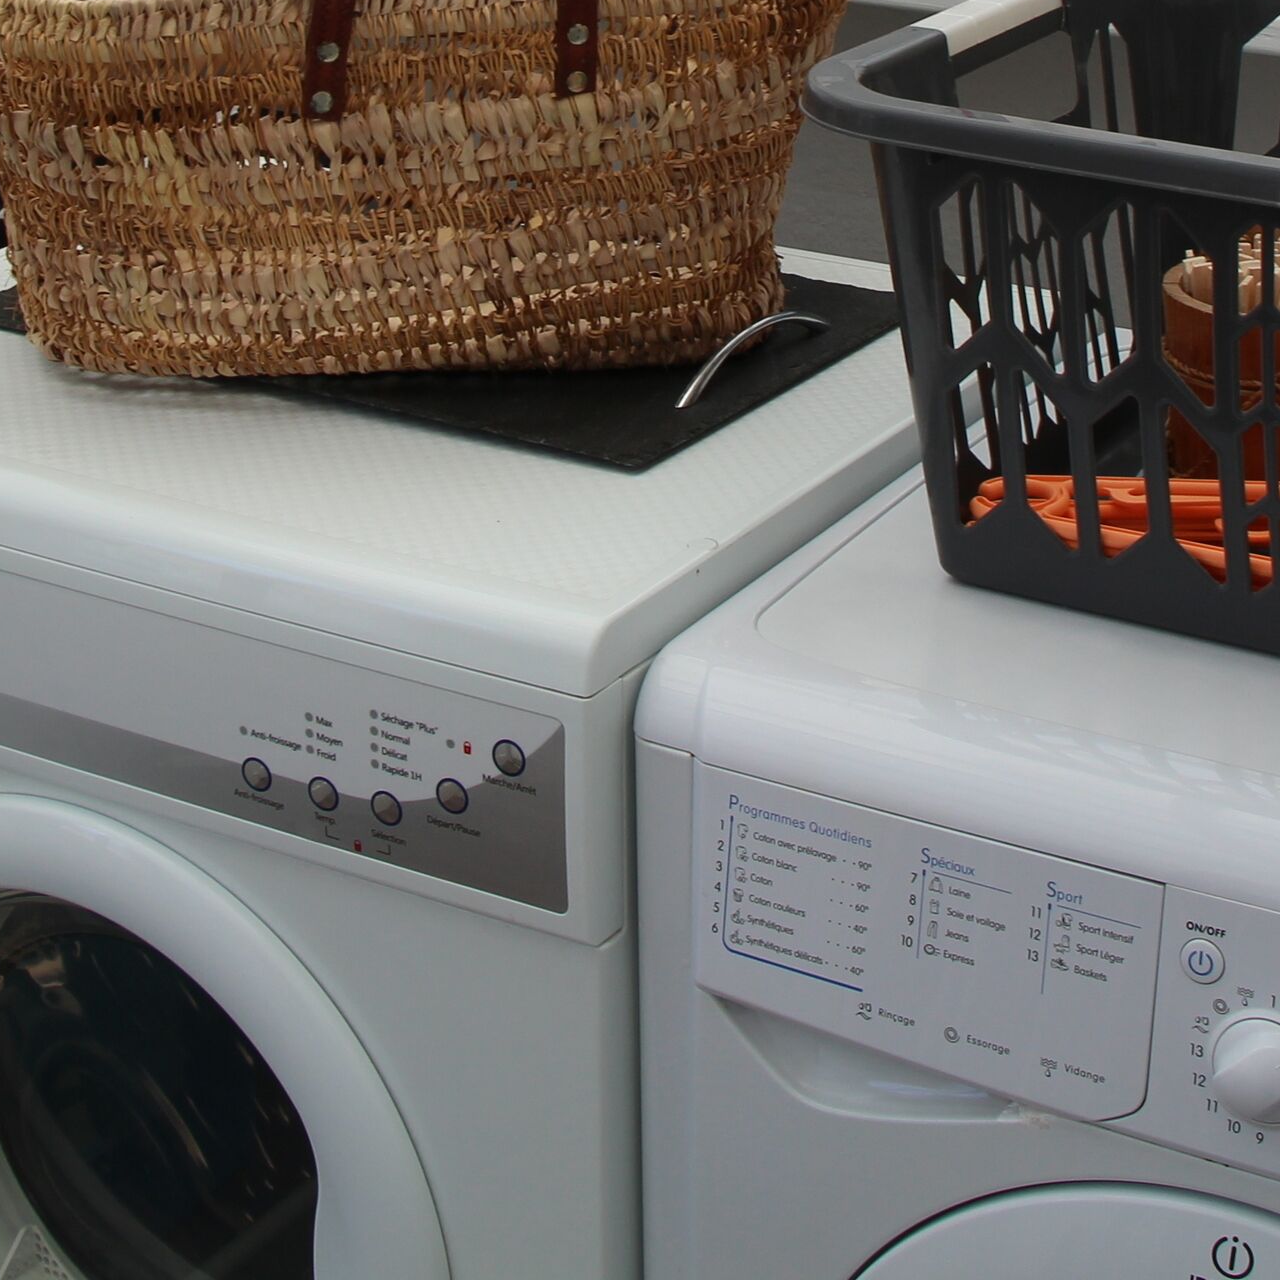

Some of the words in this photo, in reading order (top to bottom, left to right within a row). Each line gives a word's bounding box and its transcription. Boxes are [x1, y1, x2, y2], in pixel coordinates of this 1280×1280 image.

[315, 716, 333, 728] Max
[380, 712, 414, 730] Séchage
[316, 732, 344, 747] Moyen
[381, 730, 411, 746] Normal
[316, 749, 337, 761] Froid
[381, 746, 408, 761] Délicat
[381, 763, 409, 778] Rapide
[729, 794, 805, 830] Programmes
[809, 821, 872, 848] Quotidiens
[717, 840, 724, 851] 2
[751, 852, 774, 866] Coton
[776, 859, 797, 872] blanc
[753, 831, 776, 846] Coton
[778, 839, 796, 851] avec
[797, 844, 837, 863] prélavage
[921, 847, 975, 876] Spéciaux
[716, 861, 723, 872] 3
[750, 873, 773, 887] Coton
[911, 872, 918, 883] 7
[949, 886, 971, 899] Laine
[1046, 881, 1083, 905] Sport
[713, 902, 720, 913] 5
[714, 881, 721, 892] 4
[749, 894, 771, 908] Coton
[773, 901, 806, 918] couleurs
[909, 894, 917, 905] 8
[947, 907, 965, 920] Soie
[966, 914, 974, 922] et
[712, 923, 719, 933] 6
[907, 915, 915, 926] 9
[945, 929, 969, 942] Jeans
[1031, 906, 1042, 918] 11
[1078, 922, 1101, 935] Sport
[1186, 921, 1226, 939] ON/OFF
[901, 934, 913, 947] 10
[943, 949, 975, 966] Express
[1029, 927, 1041, 941] 12
[1076, 943, 1099, 956] Sport
[1100, 950, 1124, 964] Léger
[1027, 948, 1039, 962] 13
[1074, 965, 1107, 982] Baskets
[878, 1007, 915, 1026] Rinçage
[966, 1034, 1010, 1055] Essorage
[1190, 1042, 1204, 1058] 13
[1064, 1063, 1106, 1083] Vidange
[1192, 1072, 1207, 1088] 12
[1206, 1098, 1218, 1113] 11
[1227, 1119, 1241, 1134] 10
[1255, 1132, 1264, 1144] 9
